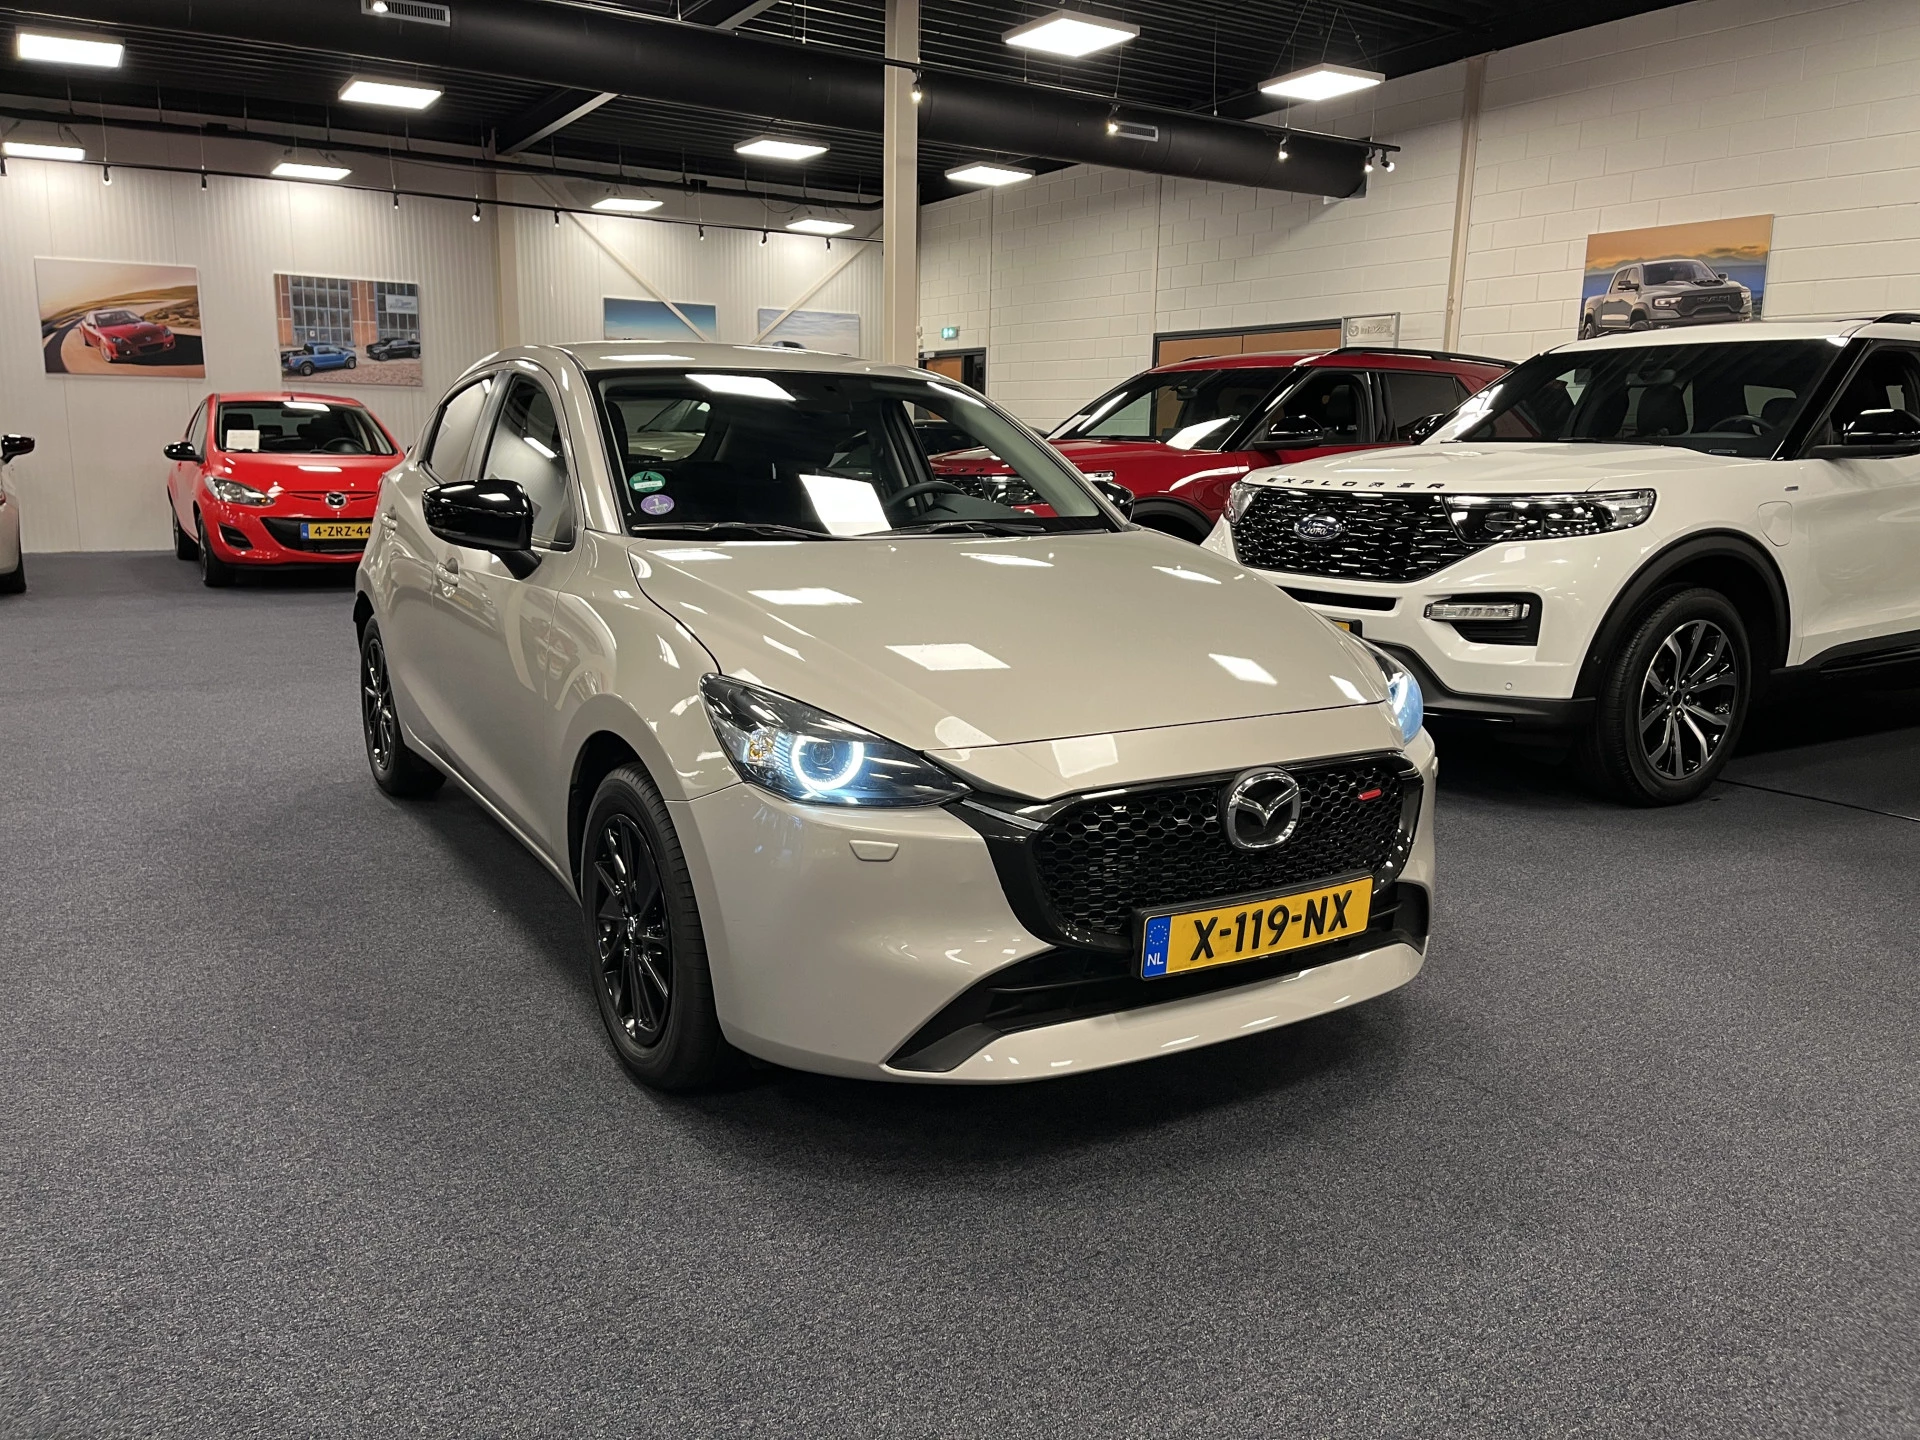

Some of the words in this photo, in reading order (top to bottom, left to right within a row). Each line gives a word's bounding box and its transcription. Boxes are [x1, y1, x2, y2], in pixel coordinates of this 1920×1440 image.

[642, 472, 652, 481] 4
[1266, 477, 1446, 489] EXPLORER
[314, 525, 371, 537] 4-ZRZ-44
[1302, 521, 1329, 536] Ford
[1190, 890, 1353, 961] X-119-NX
[1147, 952, 1164, 966] NL
